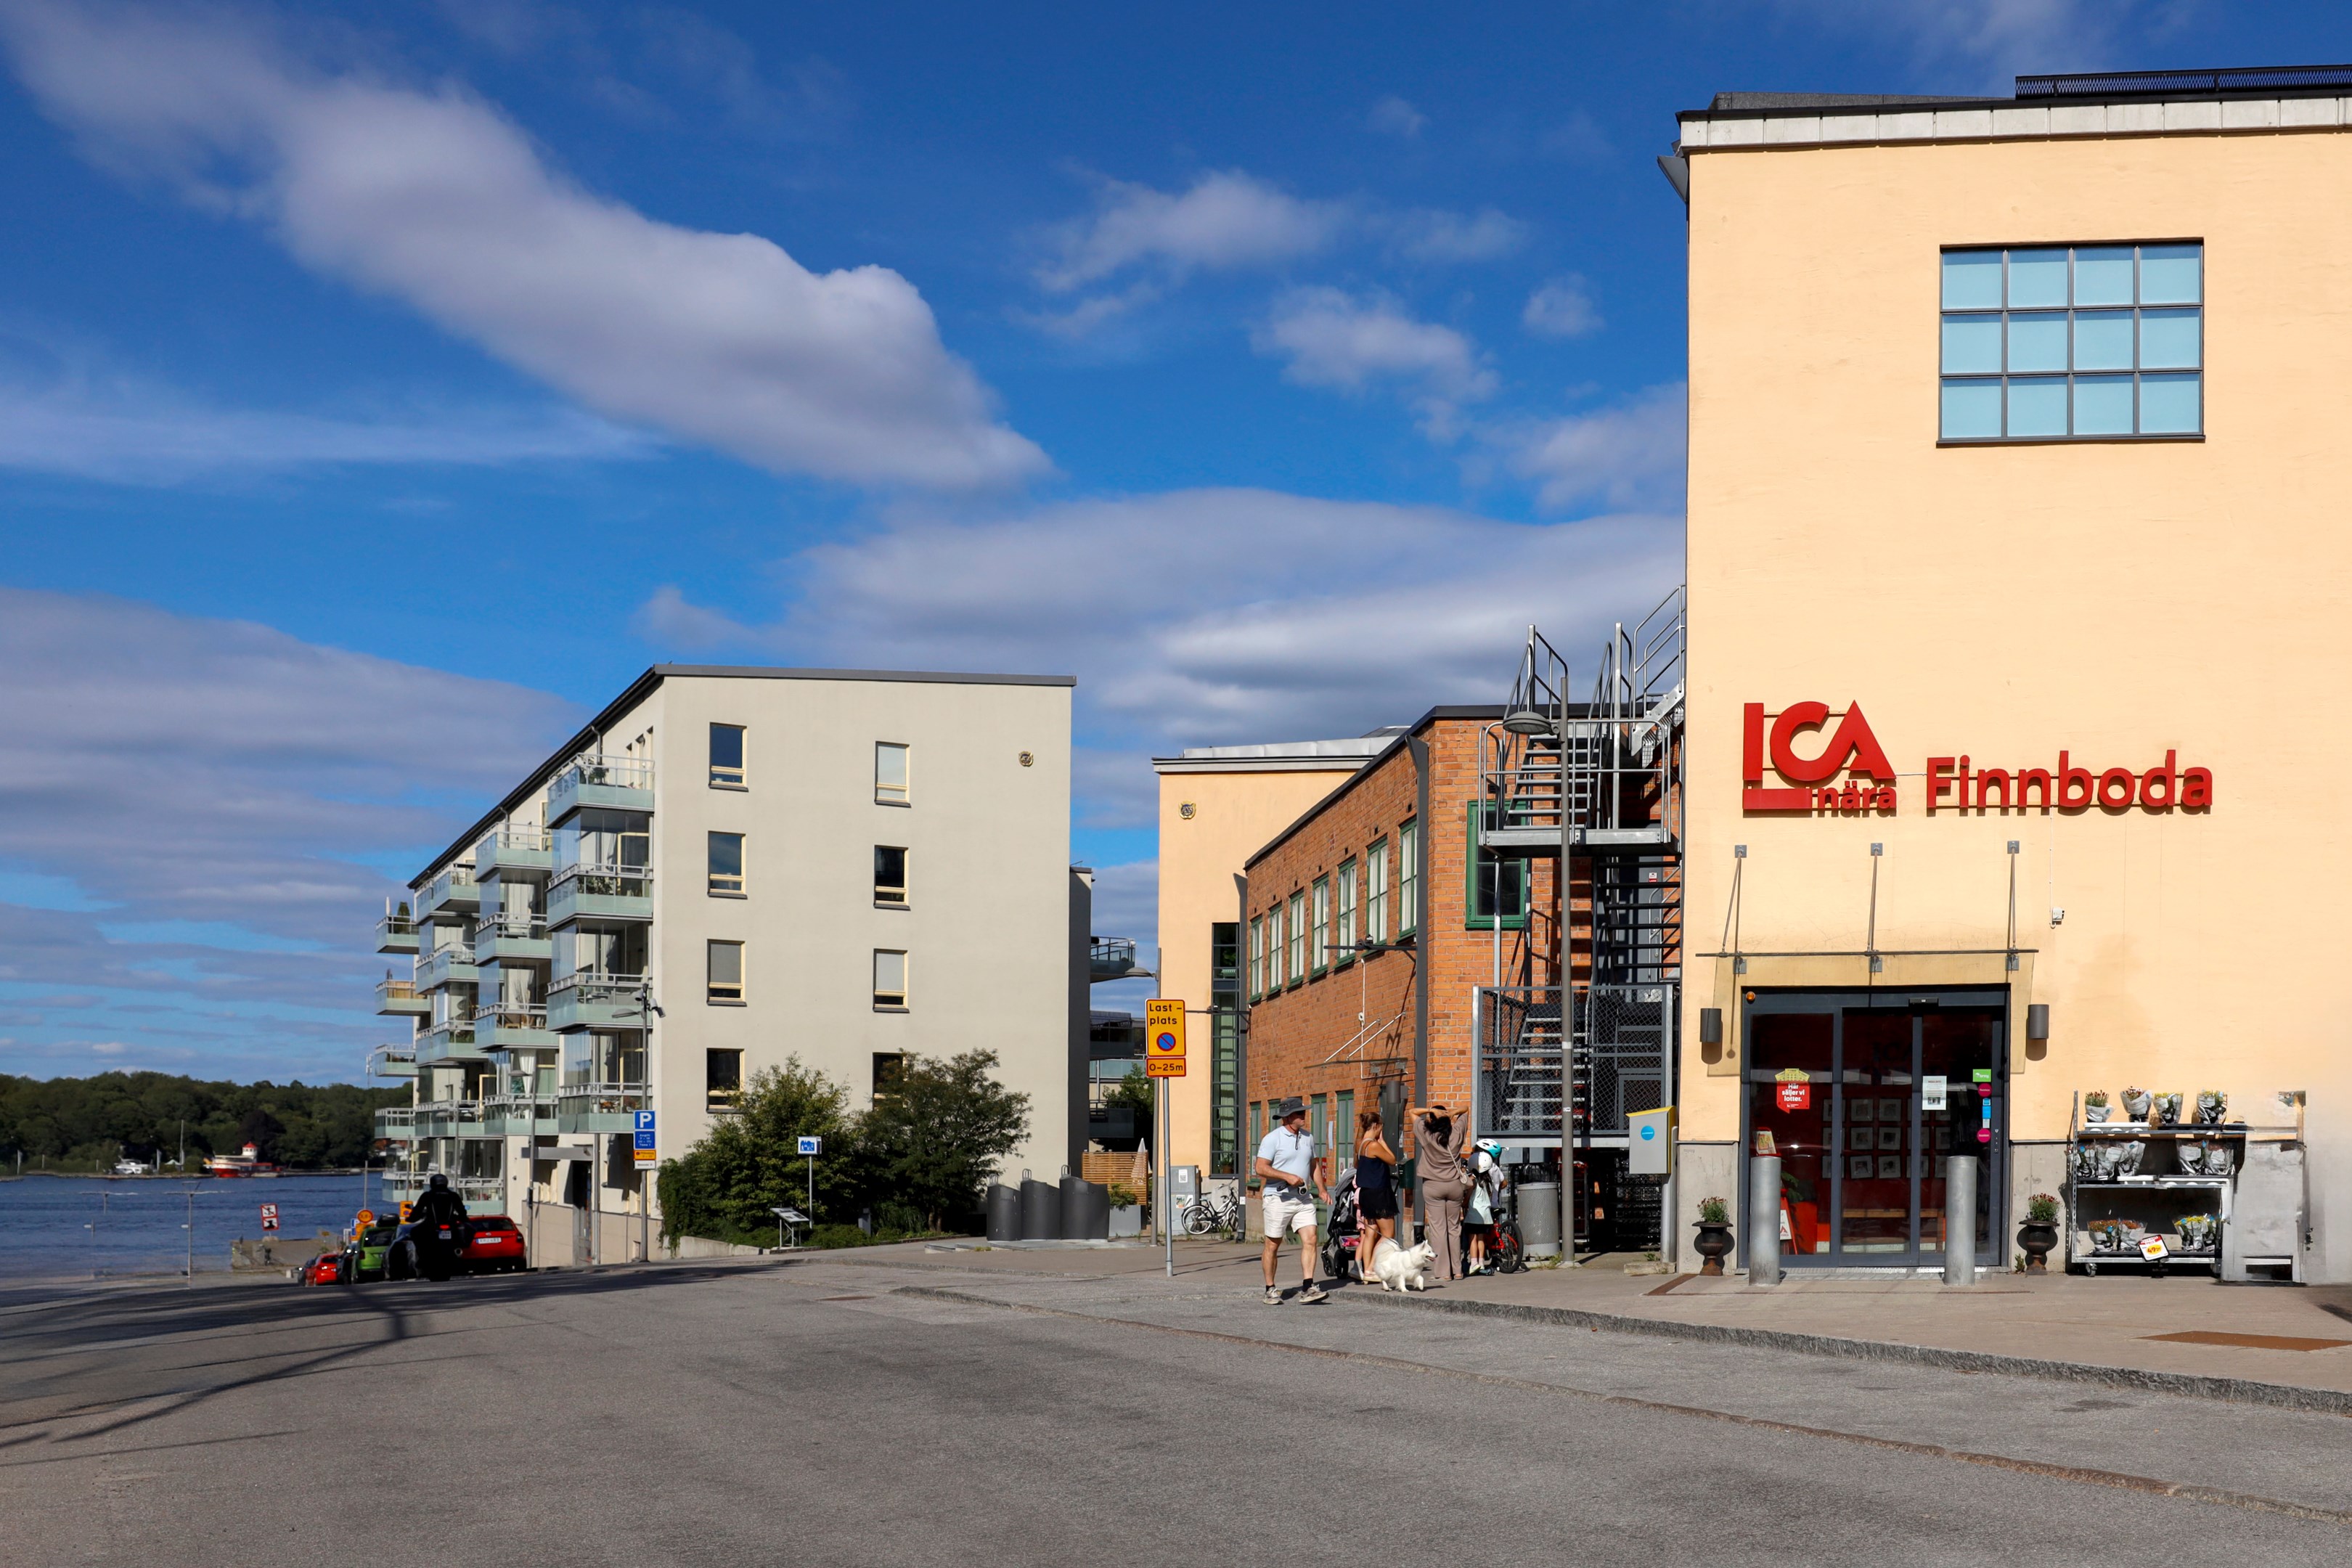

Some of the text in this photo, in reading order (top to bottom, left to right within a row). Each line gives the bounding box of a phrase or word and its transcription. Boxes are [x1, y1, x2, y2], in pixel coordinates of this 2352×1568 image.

[1743, 700, 1896, 781] ICA
[1927, 749, 2213, 808] Finnboda
[1817, 780, 1897, 809] nära
[1149, 1016, 1177, 1026] plats
[640, 1112, 653, 1128] P
